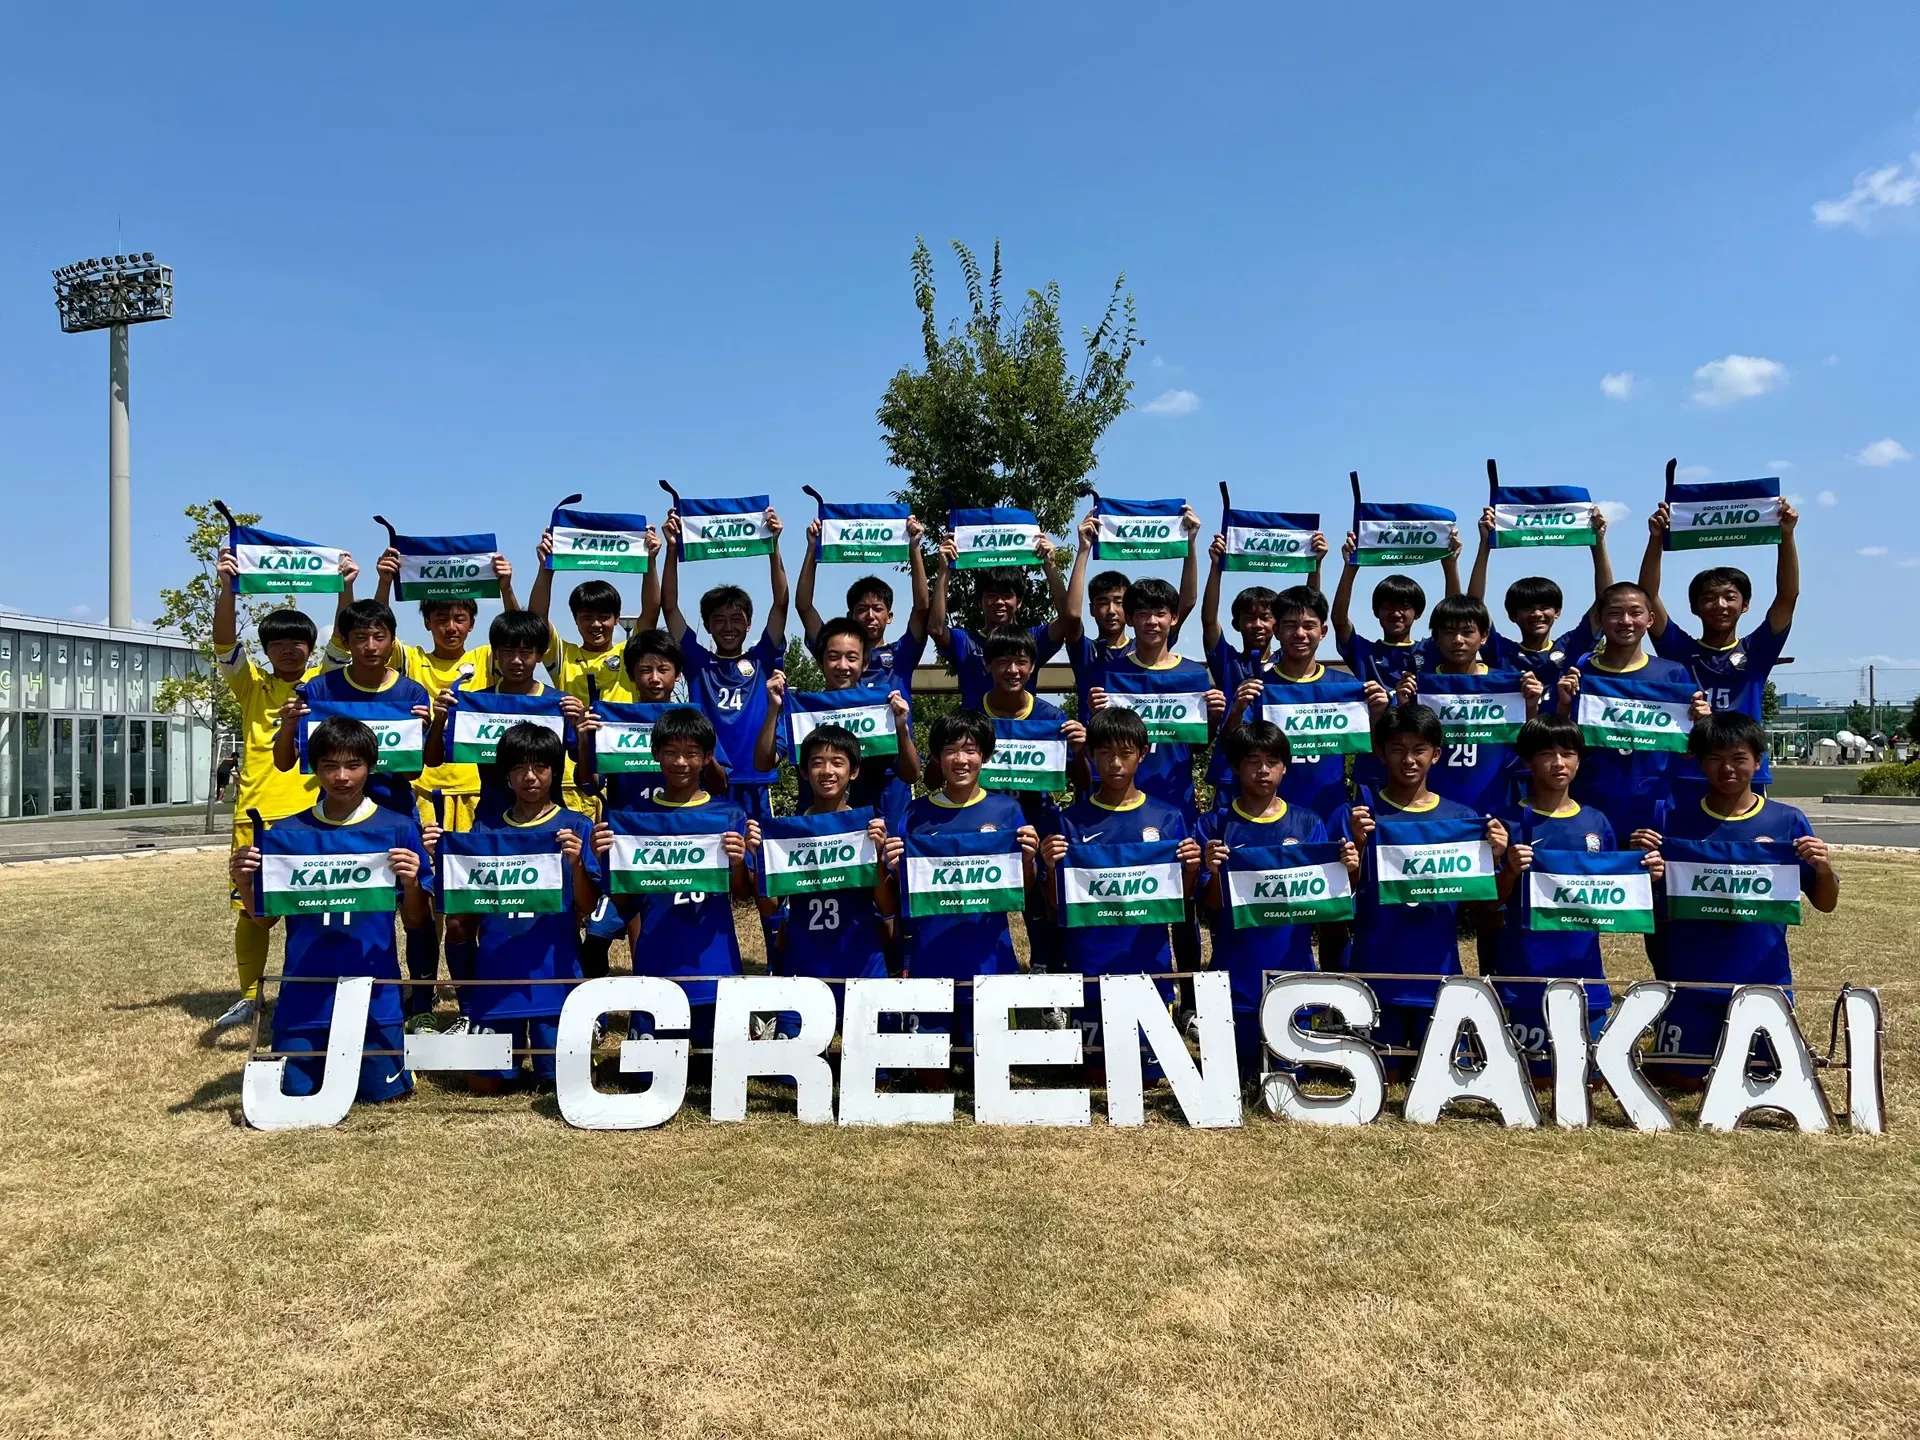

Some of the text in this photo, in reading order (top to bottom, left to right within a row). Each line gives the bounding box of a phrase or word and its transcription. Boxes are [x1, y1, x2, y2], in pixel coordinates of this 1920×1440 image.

[1516, 513, 1576, 526] KAMO
[1692, 510, 1760, 526] KAMO
[700, 524, 755, 538] KAMO
[839, 528, 893, 540] KAMO
[1116, 525, 1170, 538] KAMO
[1377, 531, 1437, 544] KAMO
[572, 538, 629, 552] KAMO
[973, 534, 1025, 546] KAMO
[1244, 538, 1299, 551] KAMO
[259, 556, 322, 570] KAMO
[420, 564, 479, 578] KAMO
[717, 687, 743, 710] 24
[1704, 687, 1730, 709] 15
[1440, 705, 1504, 720] KAMO
[1601, 707, 1671, 727] KAMO
[815, 717, 876, 733] MO
[1285, 715, 1348, 730] KAMO
[475, 724, 505, 739] KA
[617, 733, 652, 748] KA
[1448, 743, 1477, 767] 29
[632, 848, 705, 864] KAMO
[788, 845, 855, 866] KAMO
[1402, 856, 1471, 874] KAMO
[290, 867, 371, 885] KAMO
[467, 868, 538, 884] KAMO
[932, 866, 1001, 884] KAMO
[1088, 877, 1158, 896] KAMO
[1254, 878, 1325, 897] KAMO
[1691, 875, 1772, 894] KAMO
[1553, 887, 1625, 904] KAMO
[809, 898, 840, 930] 23
[242, 972, 1885, 1134] J-GREEN SAKAI
